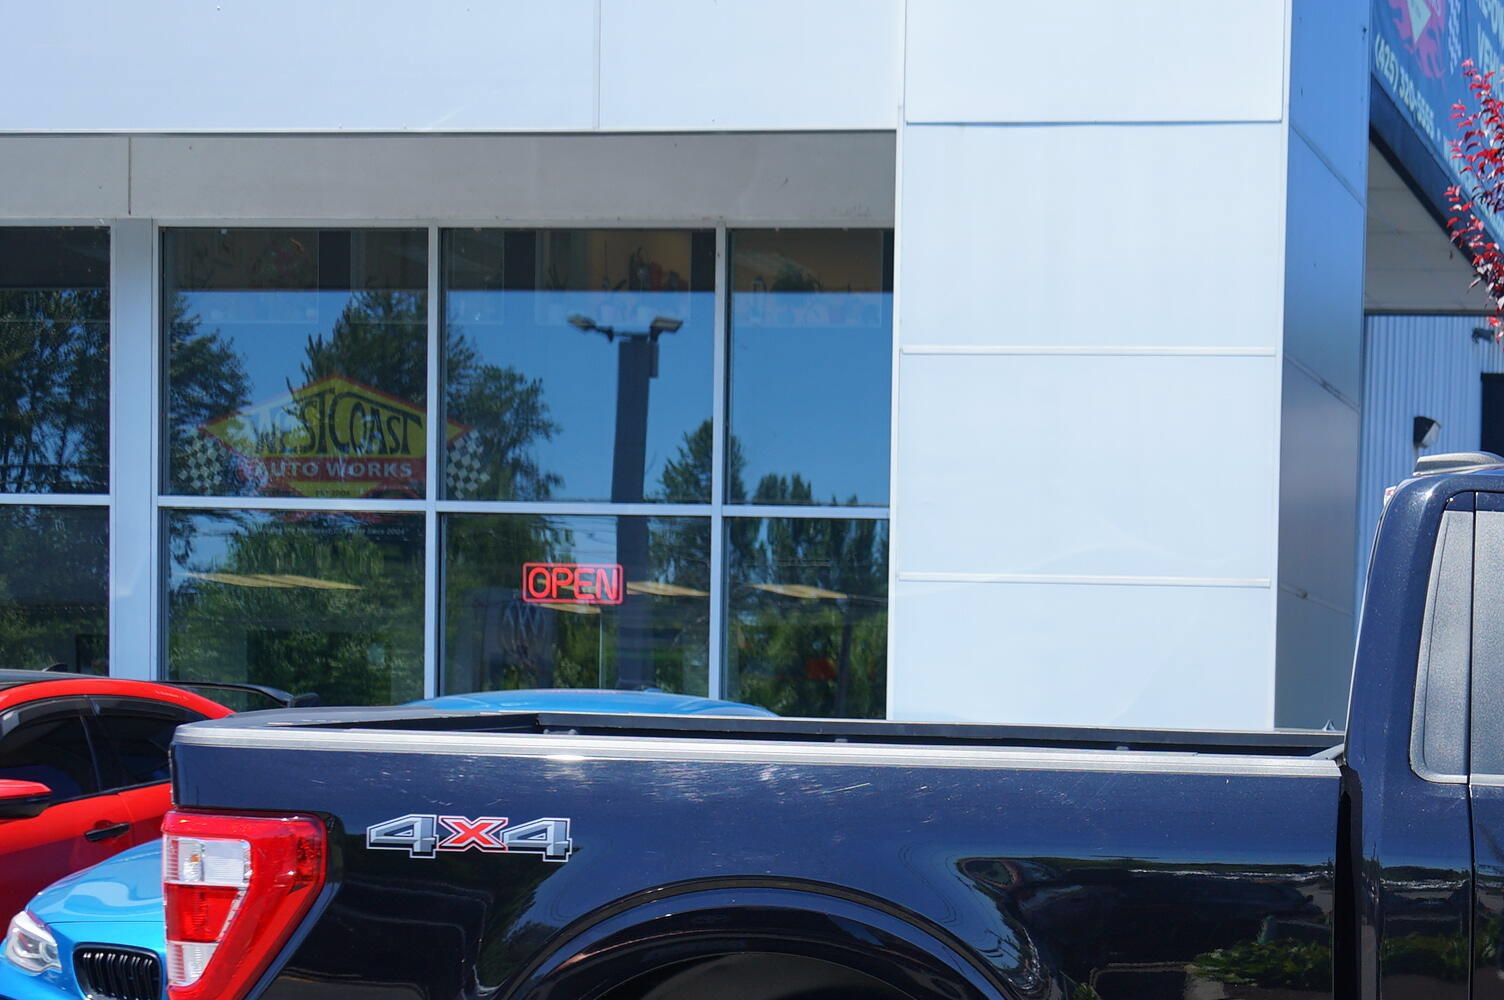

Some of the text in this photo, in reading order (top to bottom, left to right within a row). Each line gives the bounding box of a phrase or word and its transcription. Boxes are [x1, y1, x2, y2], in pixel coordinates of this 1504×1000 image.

[255, 462, 413, 478] AUTO WORKS
[526, 566, 619, 600] OPEN
